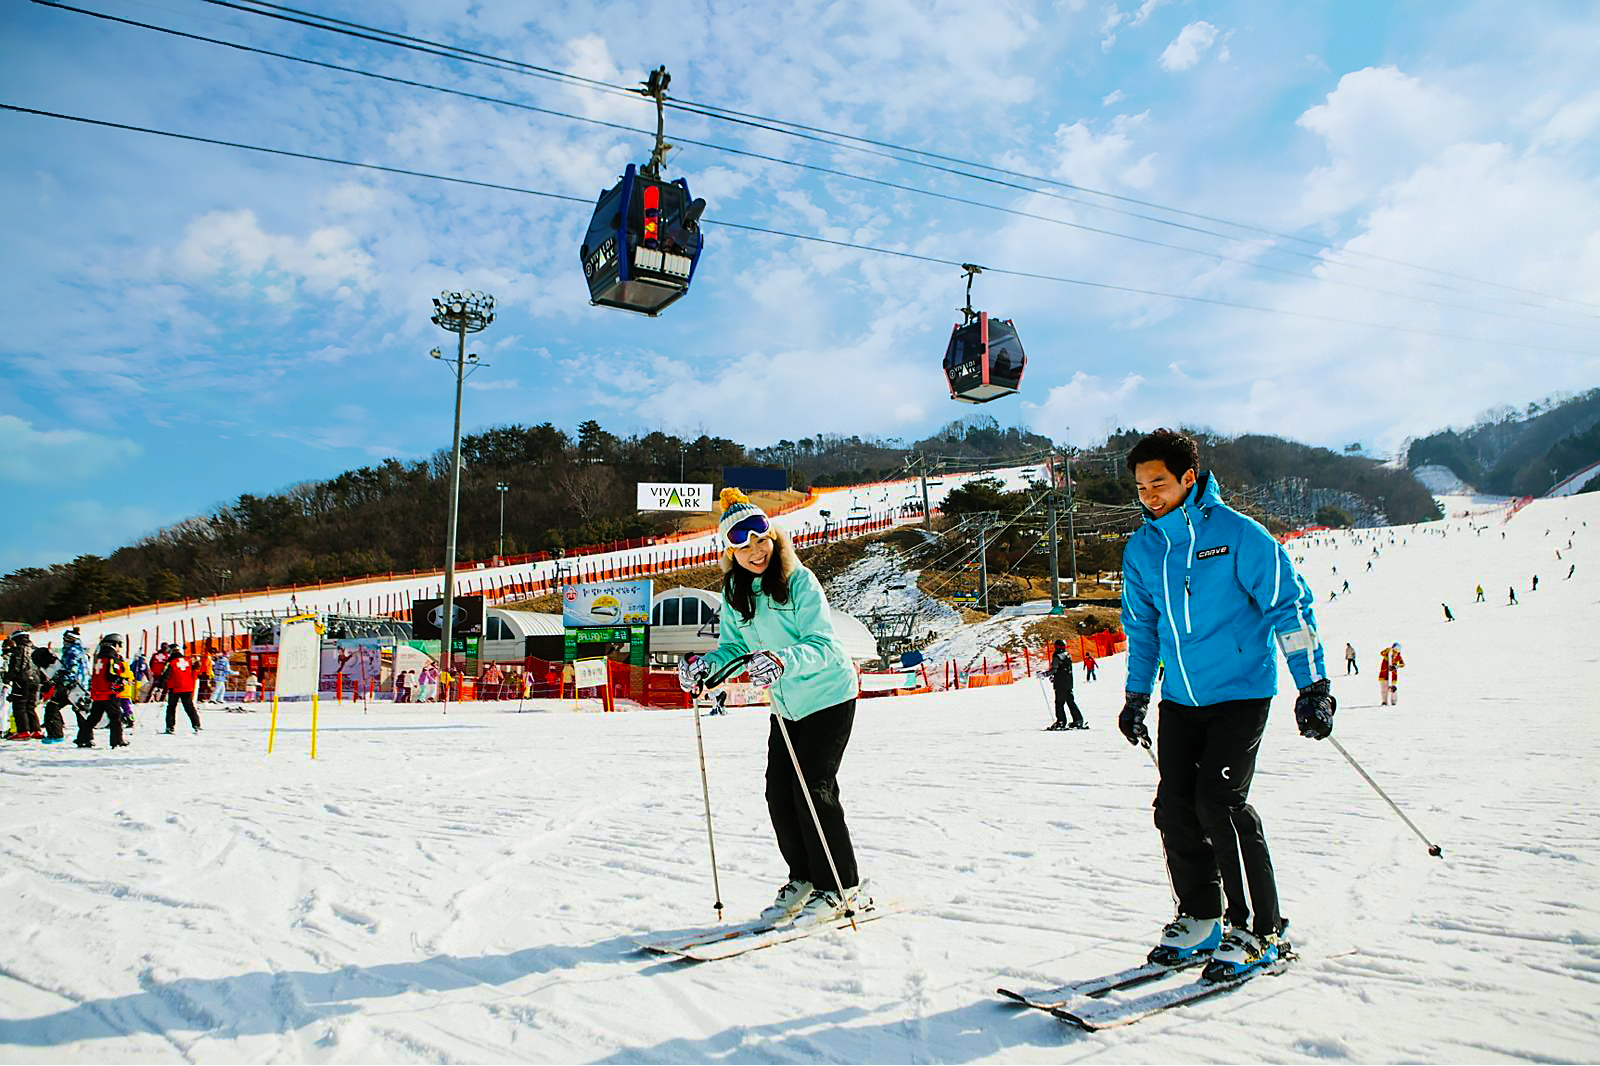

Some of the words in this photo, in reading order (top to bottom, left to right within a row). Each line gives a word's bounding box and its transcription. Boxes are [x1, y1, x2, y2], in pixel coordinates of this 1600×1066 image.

[650, 487, 701, 498] VIVALDI
[659, 495, 701, 508] PARK
[1198, 546, 1228, 558] CARVE
